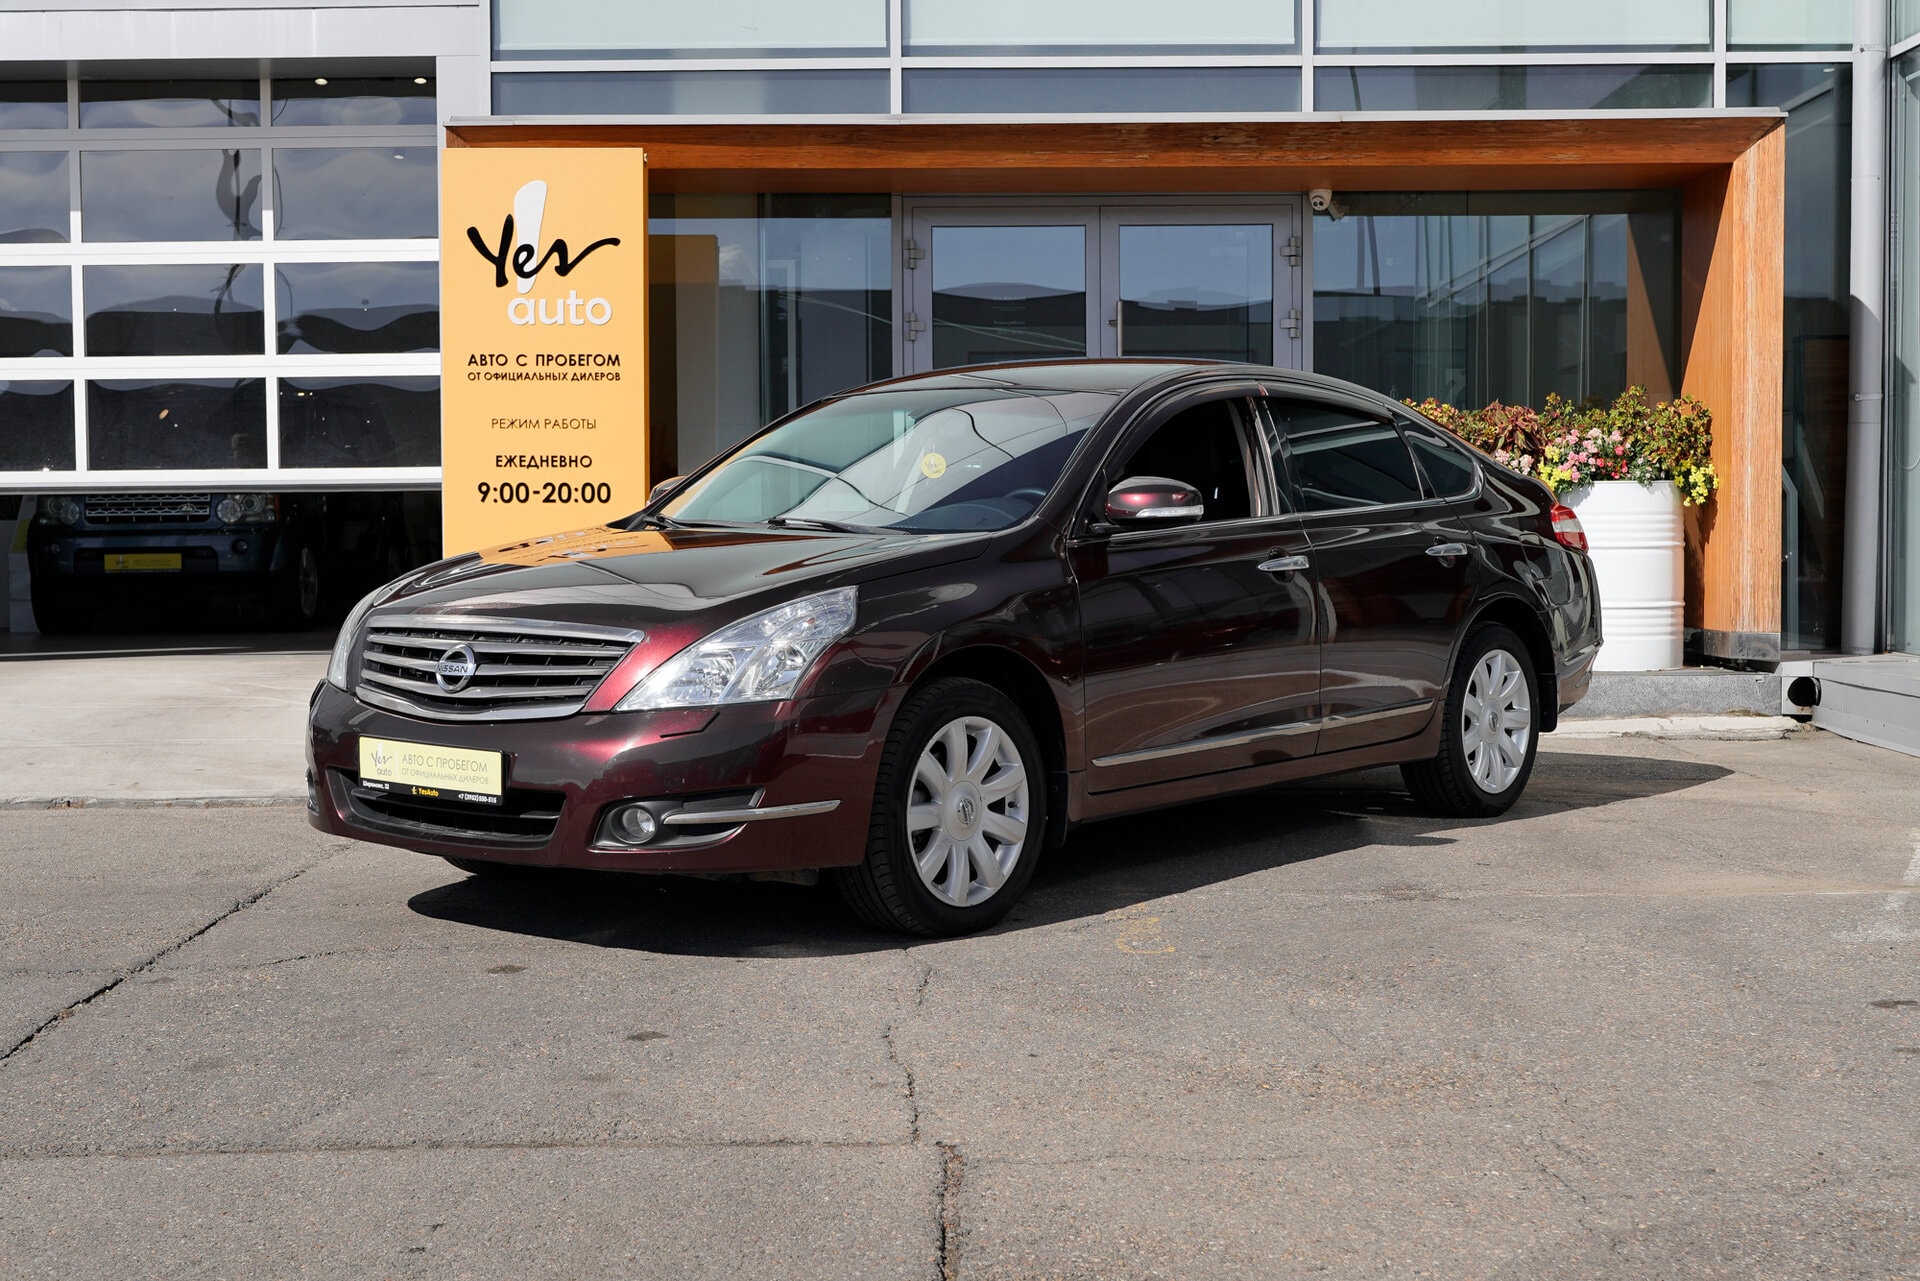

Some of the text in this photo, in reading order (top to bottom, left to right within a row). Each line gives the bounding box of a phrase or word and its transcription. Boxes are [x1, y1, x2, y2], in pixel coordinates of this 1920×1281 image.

[507, 289, 613, 326] auto
[467, 354, 621, 367] АВТО С ПРОБЕГОМ
[467, 371, 621, 382] ОТ ОФИЦИАЛЬНЫХ ДИЛЕРОВ
[491, 418, 597, 430] РЕЖИМ РАБОТЫ
[495, 455, 593, 469] ЕЖЕДНЕВНО
[477, 481, 612, 504] 9:00-20:00
[401, 753, 488, 773] АВТО С ПРОБЕГОМ
[376, 768, 392, 777] auto
